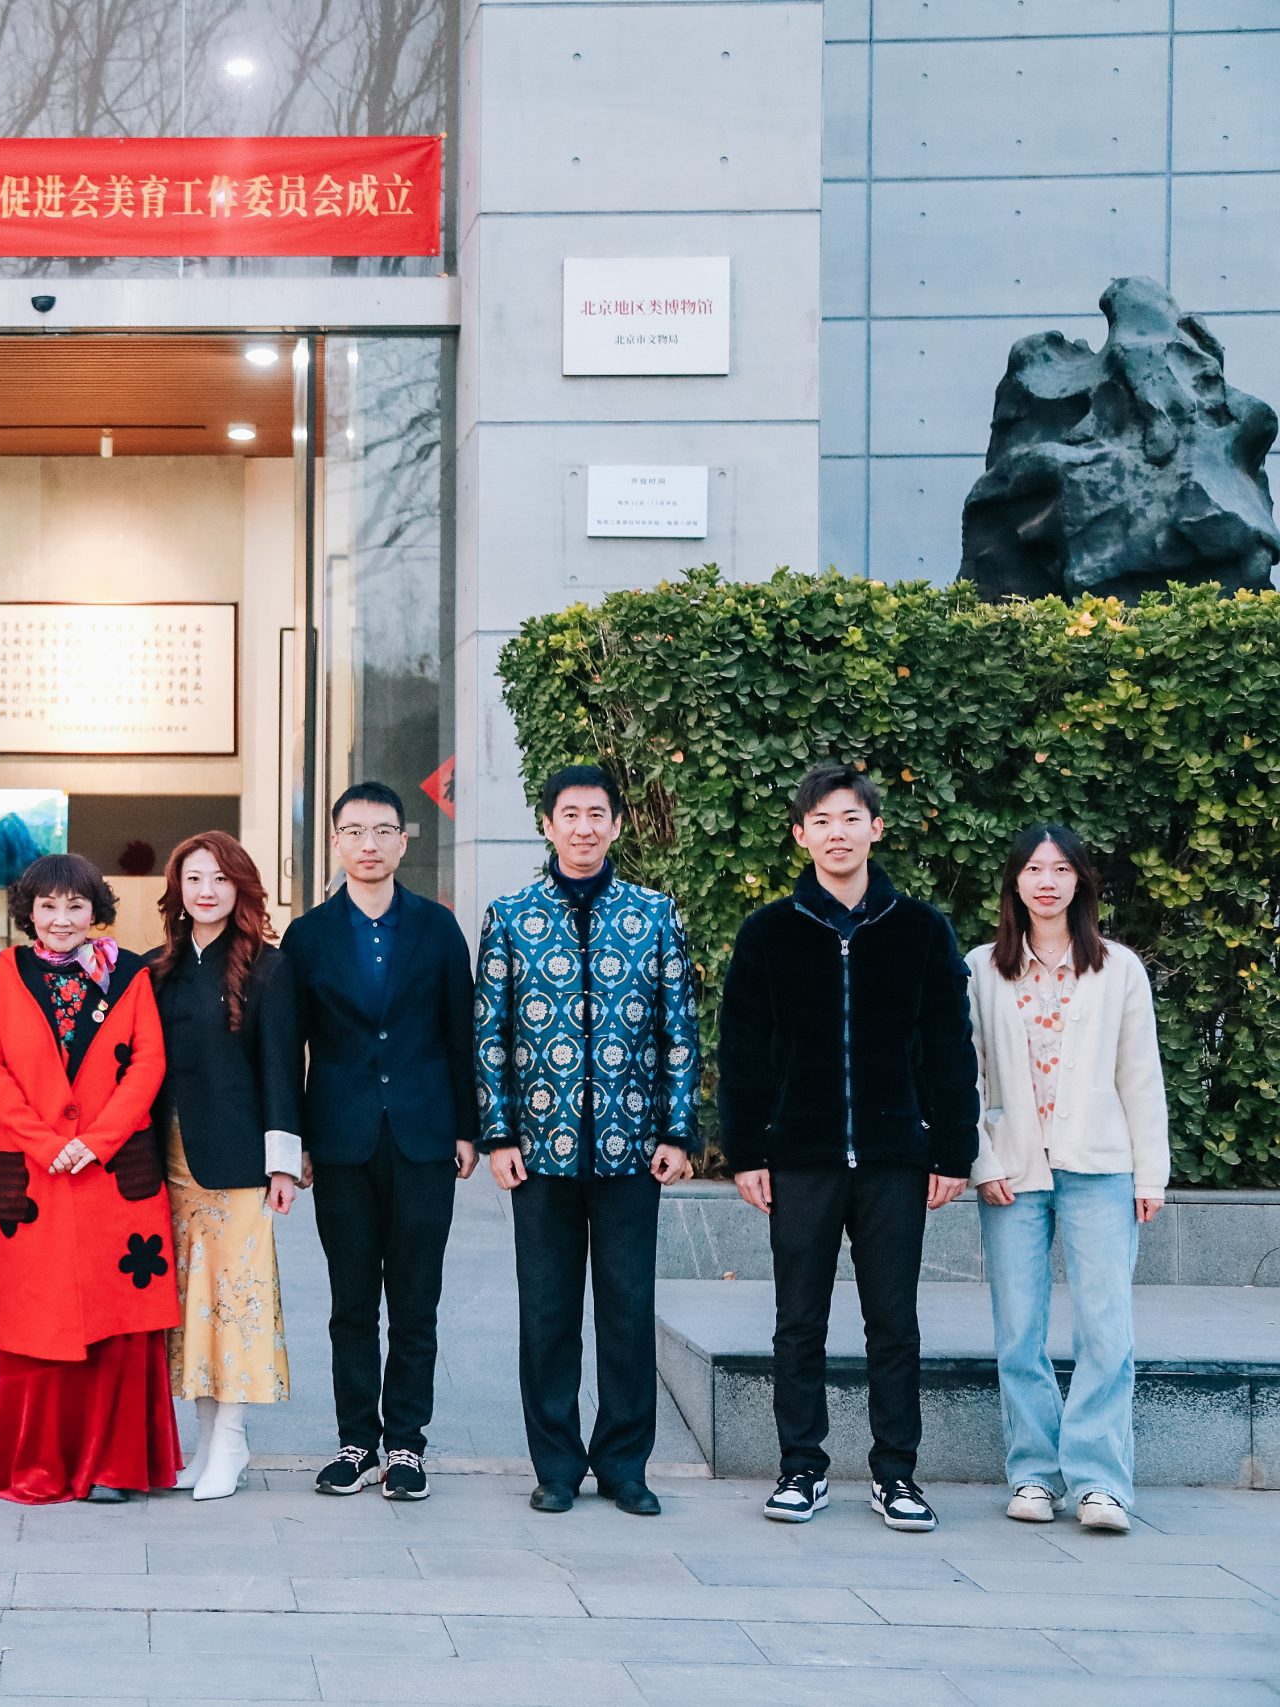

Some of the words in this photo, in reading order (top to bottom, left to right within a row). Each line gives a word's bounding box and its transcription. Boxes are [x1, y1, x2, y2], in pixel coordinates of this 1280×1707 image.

[580, 299, 713, 316] 北京地区类博物馆
[615, 334, 679, 345] 北京市文物局
